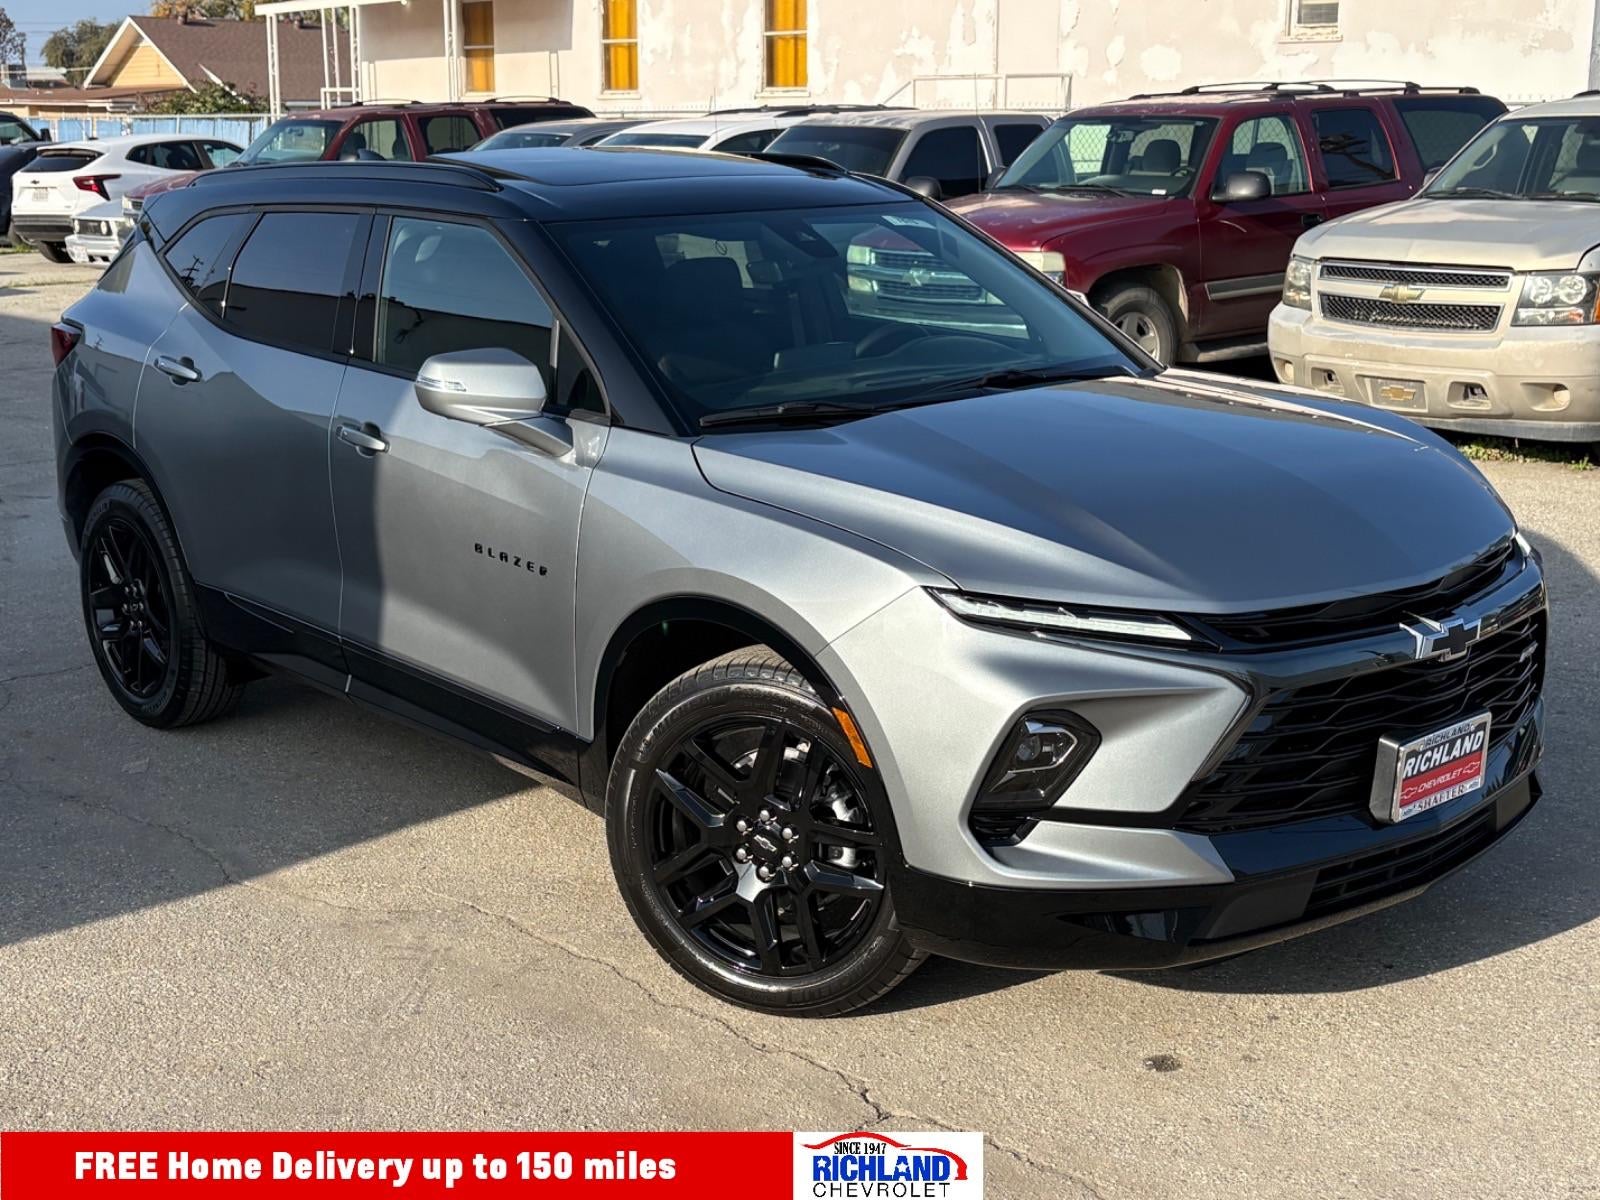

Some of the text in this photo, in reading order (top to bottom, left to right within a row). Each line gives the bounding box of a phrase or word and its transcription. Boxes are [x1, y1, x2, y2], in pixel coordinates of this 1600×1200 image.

[474, 542, 548, 576] BLAZER
[1402, 730, 1484, 779] RICHLAND
[1418, 767, 1464, 793] CHEVROLET
[1417, 784, 1466, 811] SHAFTER
